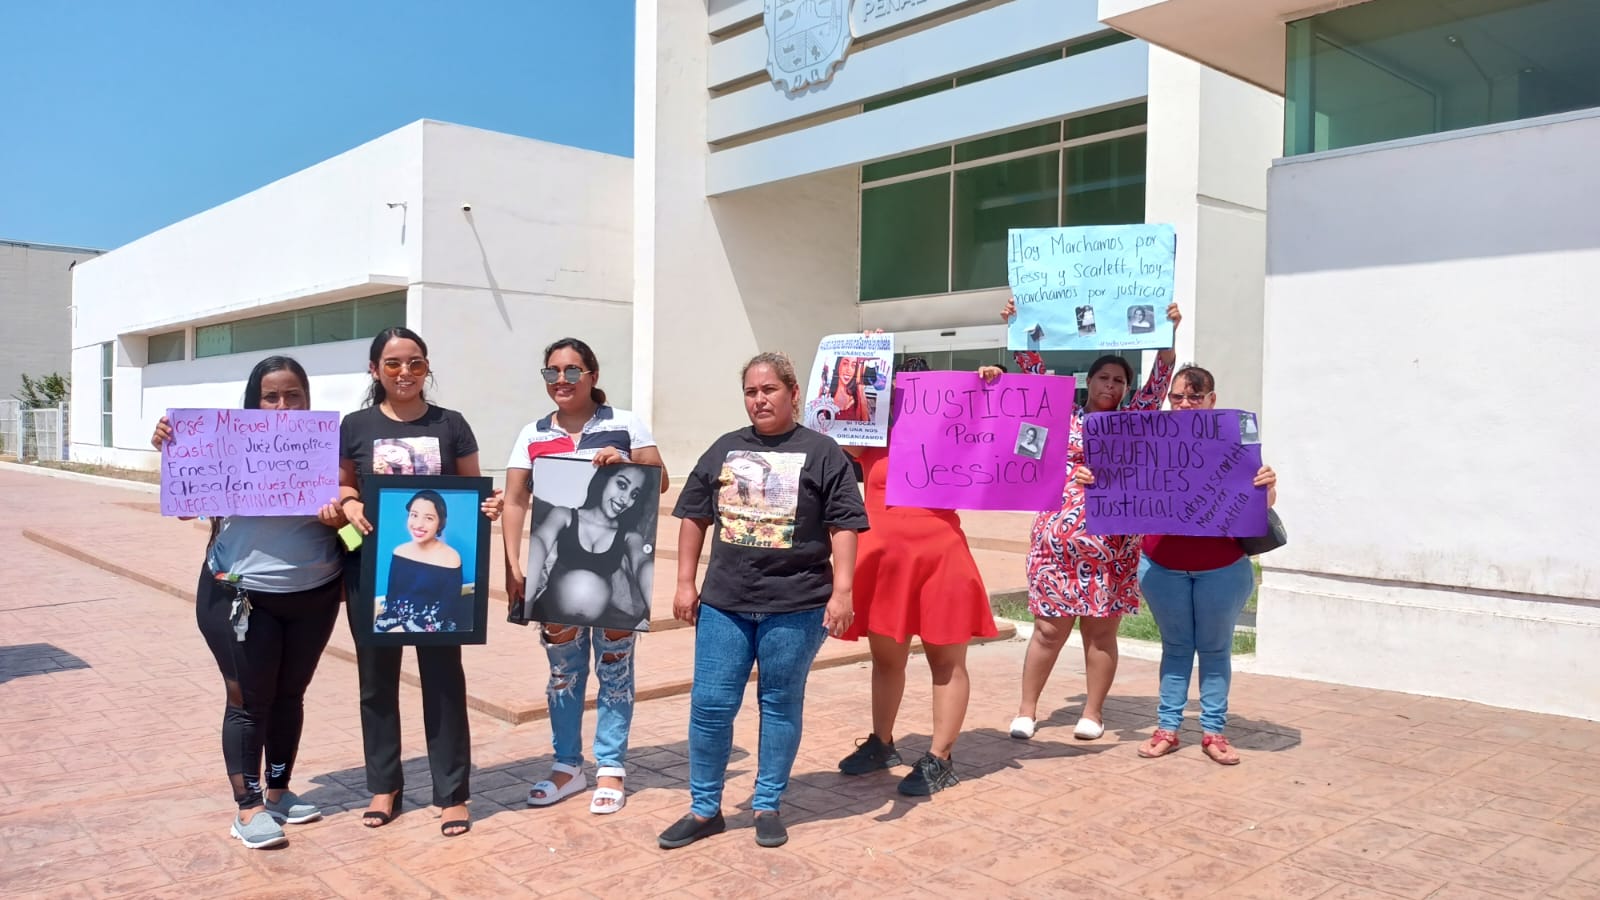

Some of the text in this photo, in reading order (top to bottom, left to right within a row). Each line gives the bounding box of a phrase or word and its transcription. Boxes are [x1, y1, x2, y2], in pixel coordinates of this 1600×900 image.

[1011, 233, 1157, 263] Hoy Marchamos por
[1011, 258, 1162, 287] Jessy y Scarlett, hoy
[1014, 285, 1078, 305] marchamos
[1088, 290, 1106, 304] por
[904, 378, 1053, 419] JUSTICIA
[171, 409, 337, 436] José Miguel Moreno
[945, 423, 996, 445] Para
[1086, 413, 1227, 442] QUEREMOS QUE
[168, 456, 310, 479] Ernesto Lovera
[905, 444, 1038, 489] Jessica
[1087, 439, 1205, 469] PAGUEN LOS
[167, 496, 220, 513] JUECES
[1090, 494, 1174, 518] Justicia!
[1177, 494, 1208, 523] Gaby
[1203, 483, 1217, 496] y
